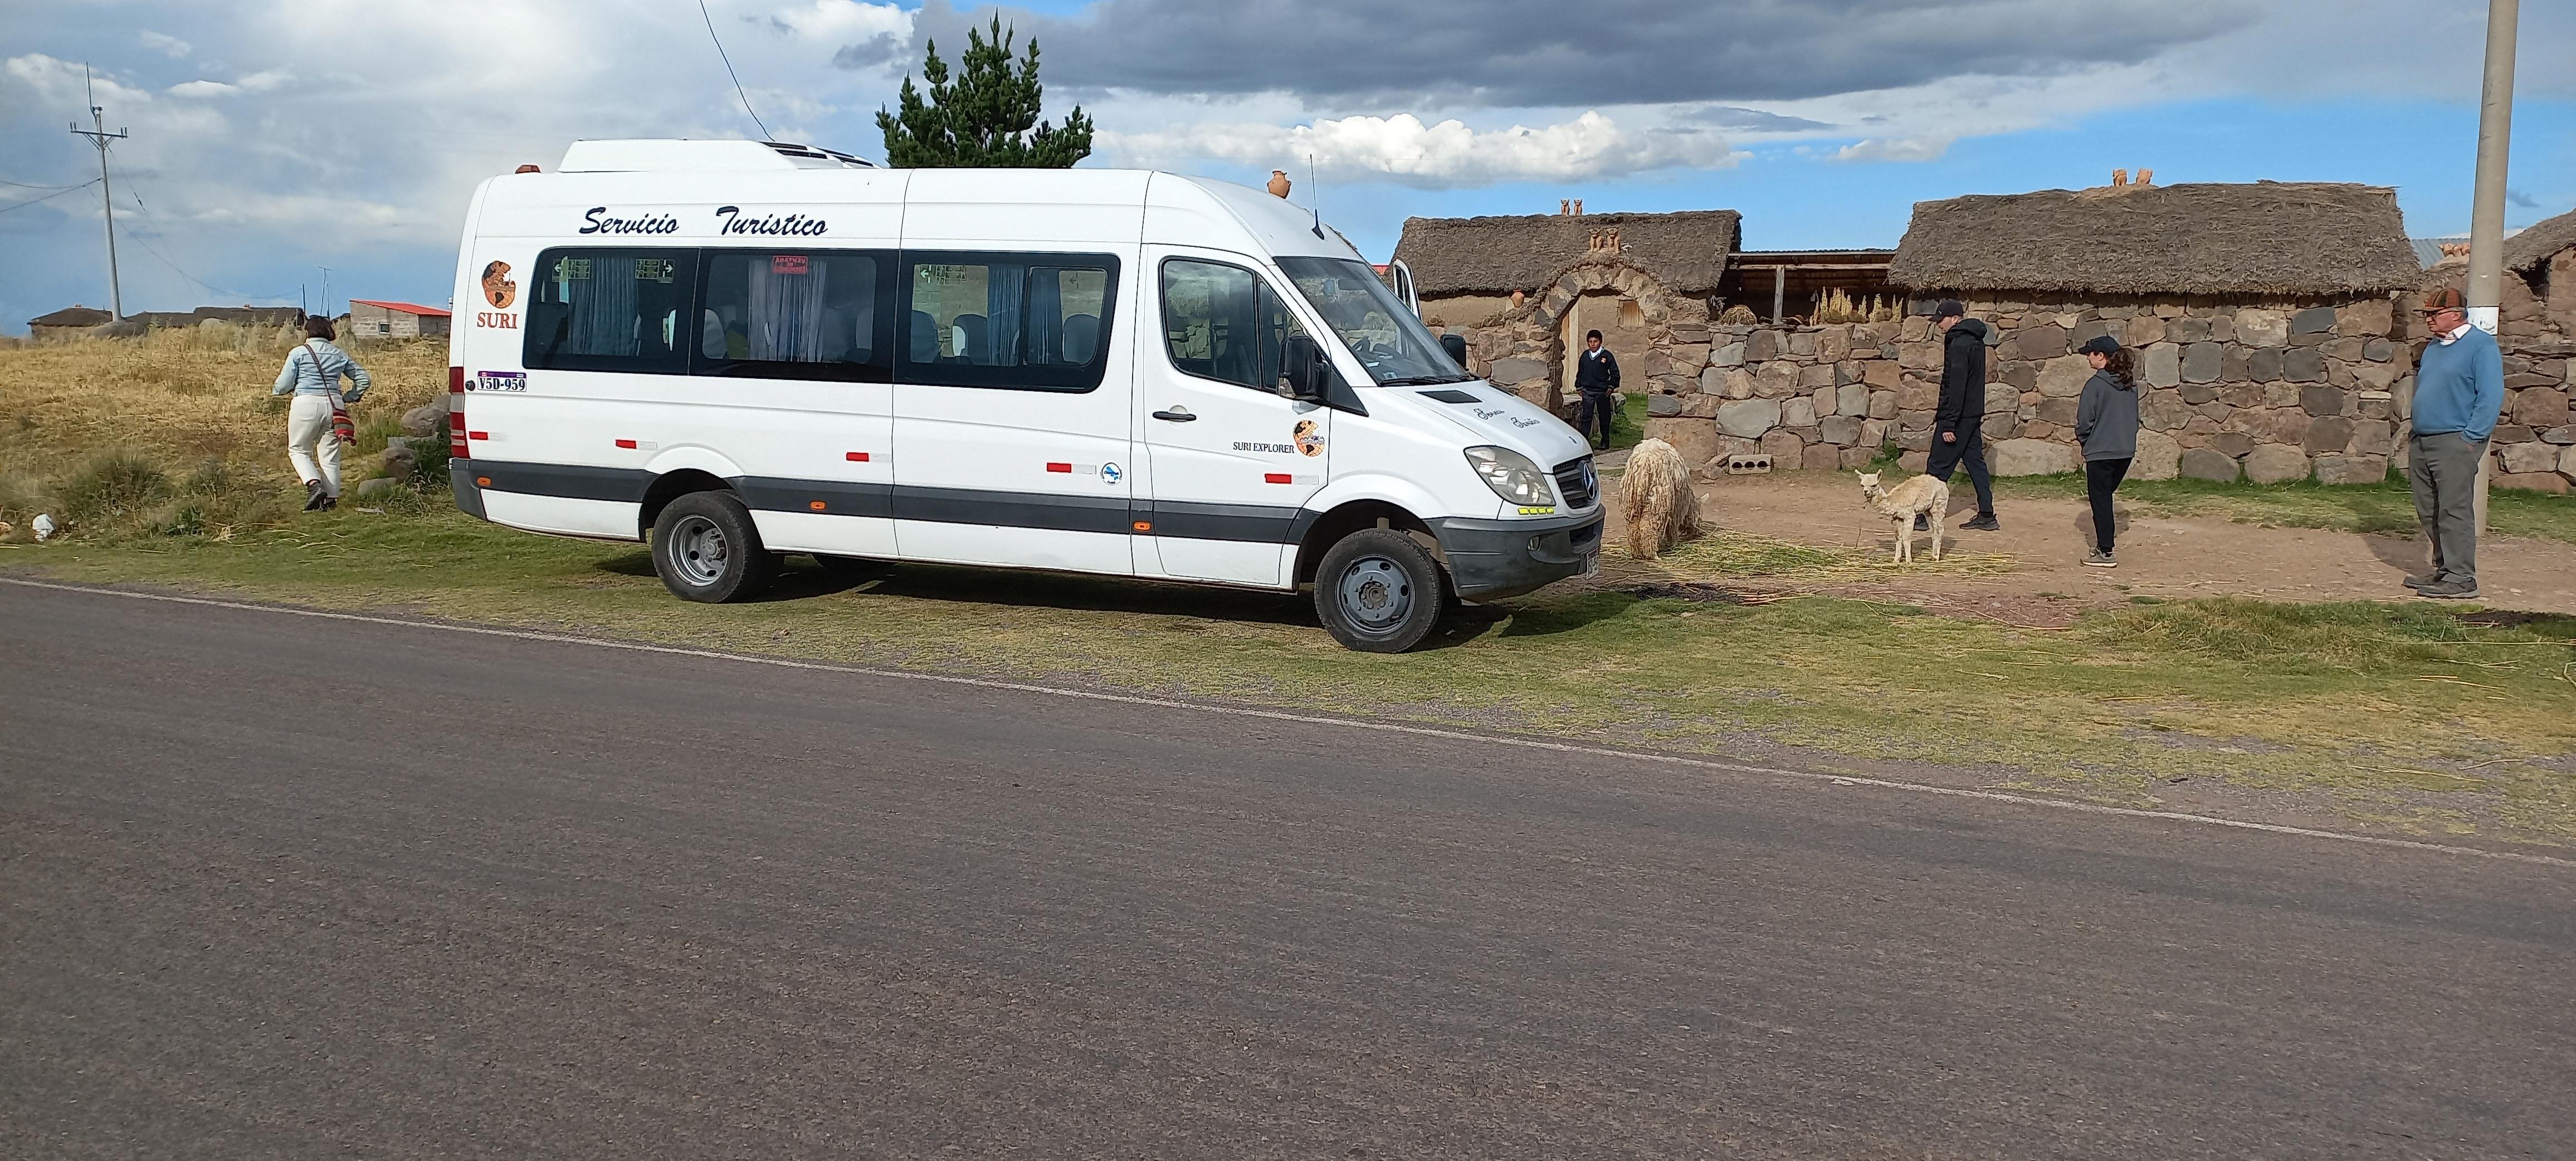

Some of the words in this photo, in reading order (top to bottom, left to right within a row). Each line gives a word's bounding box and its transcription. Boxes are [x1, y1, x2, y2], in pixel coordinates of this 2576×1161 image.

[578, 207, 680, 235] Servicio
[715, 206, 828, 236] Turistico
[477, 312, 518, 329] SURI
[479, 377, 525, 391] V5D-959
[1233, 441, 1251, 451] SURI
[1253, 442, 1295, 453] EXPLORER
